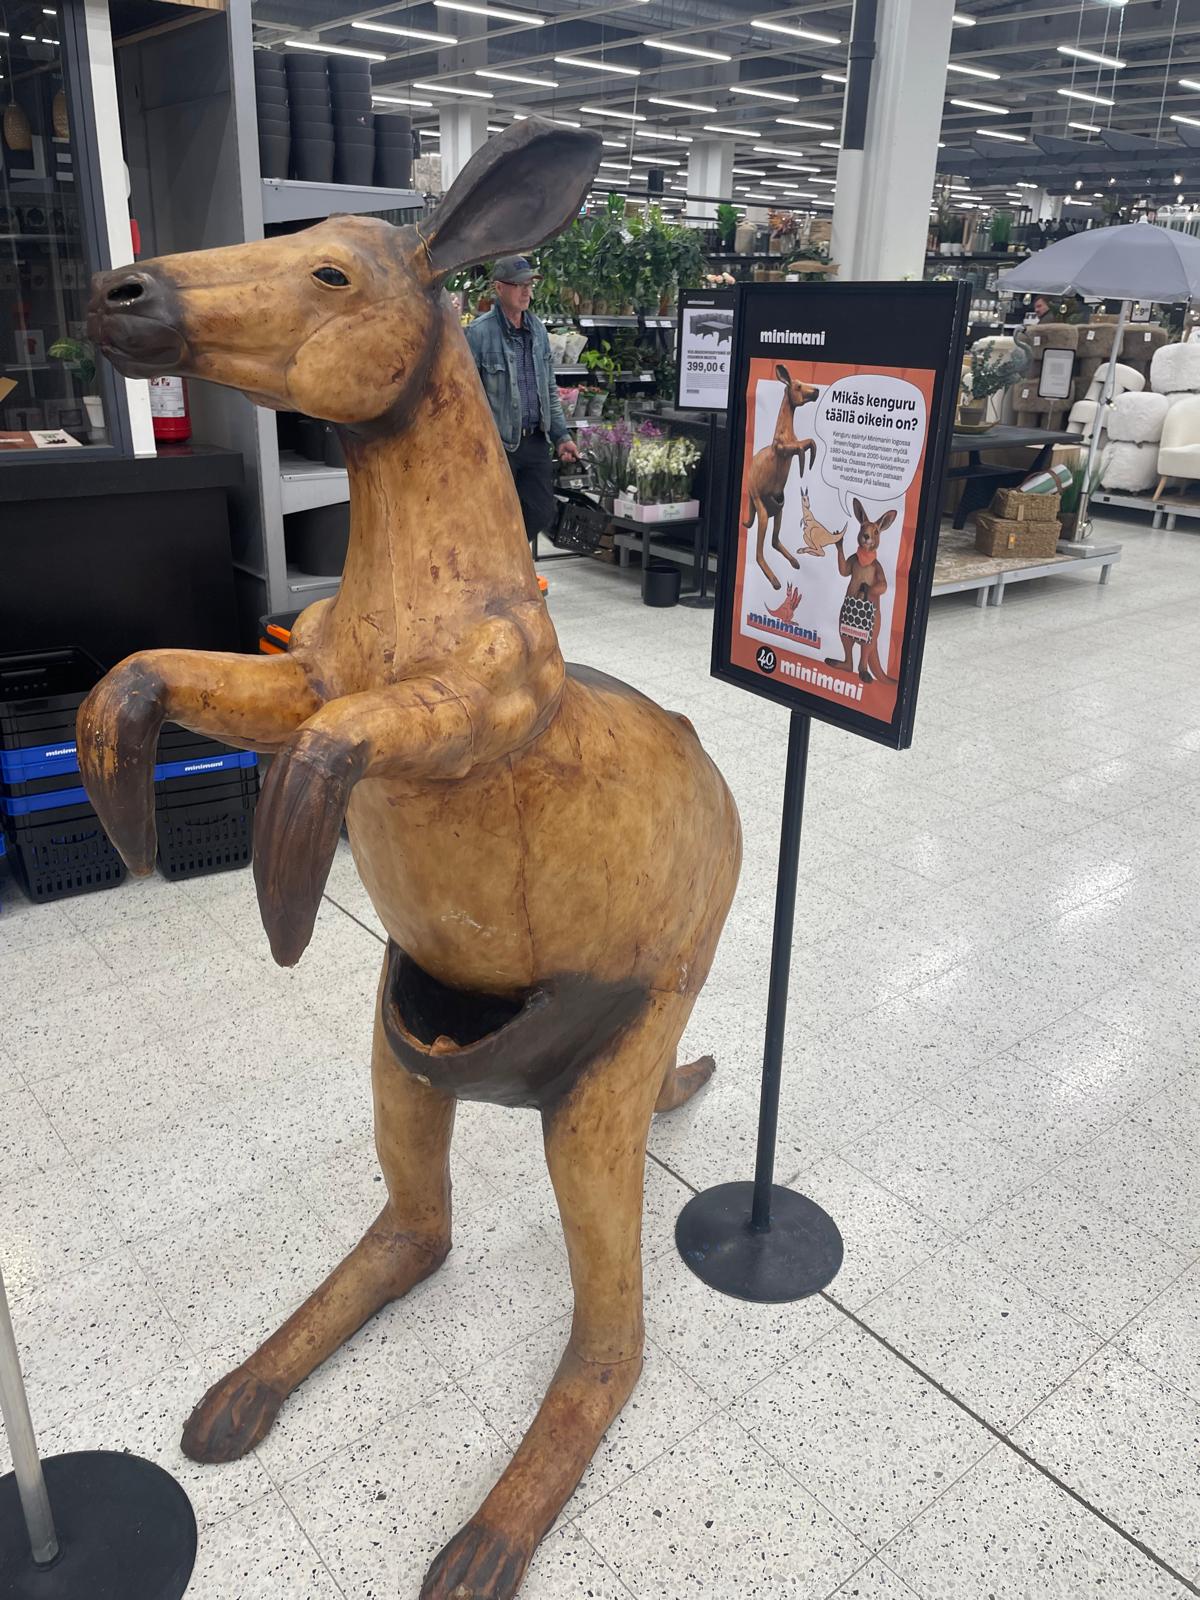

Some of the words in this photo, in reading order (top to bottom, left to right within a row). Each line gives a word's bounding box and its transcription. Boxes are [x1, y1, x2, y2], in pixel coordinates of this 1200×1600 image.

[760, 329, 826, 346] minimani
[687, 361, 718, 373] 399,00
[720, 362, 726, 372] €
[831, 390, 865, 406] Mikäs
[866, 393, 916, 412] kenguru
[825, 408, 855, 424] täällä
[857, 412, 893, 428] oikein
[895, 417, 919, 431] on?
[832, 431, 851, 440] Kenguru
[867, 435, 891, 444] Minimanin
[892, 438, 911, 447] logossa
[830, 447, 856, 457] 1980-luvulta
[867, 452, 893, 462] 2000-luvun
[893, 456, 910, 465] alkuun
[861, 443, 893, 453] uudistamisen
[893, 447, 908, 456] myötä
[832, 456, 848, 464] saakka.
[848, 458, 866, 467] Osassa
[866, 461, 905, 473] myymälöitämme
[832, 464, 843, 472] tämä
[843, 466, 857, 474] vanha
[857, 467, 877, 477] kenguru
[882, 472, 903, 481] patsaan
[840, 474, 863, 484] muodossa
[863, 477, 872, 486] yhä
[872, 479, 891, 489] tallessa.
[749, 612, 818, 642] minimani
[757, 649, 774, 667] 40
[780, 660, 864, 701] minimani
[45, 747, 77, 757] minim
[184, 760, 224, 772] minimani
